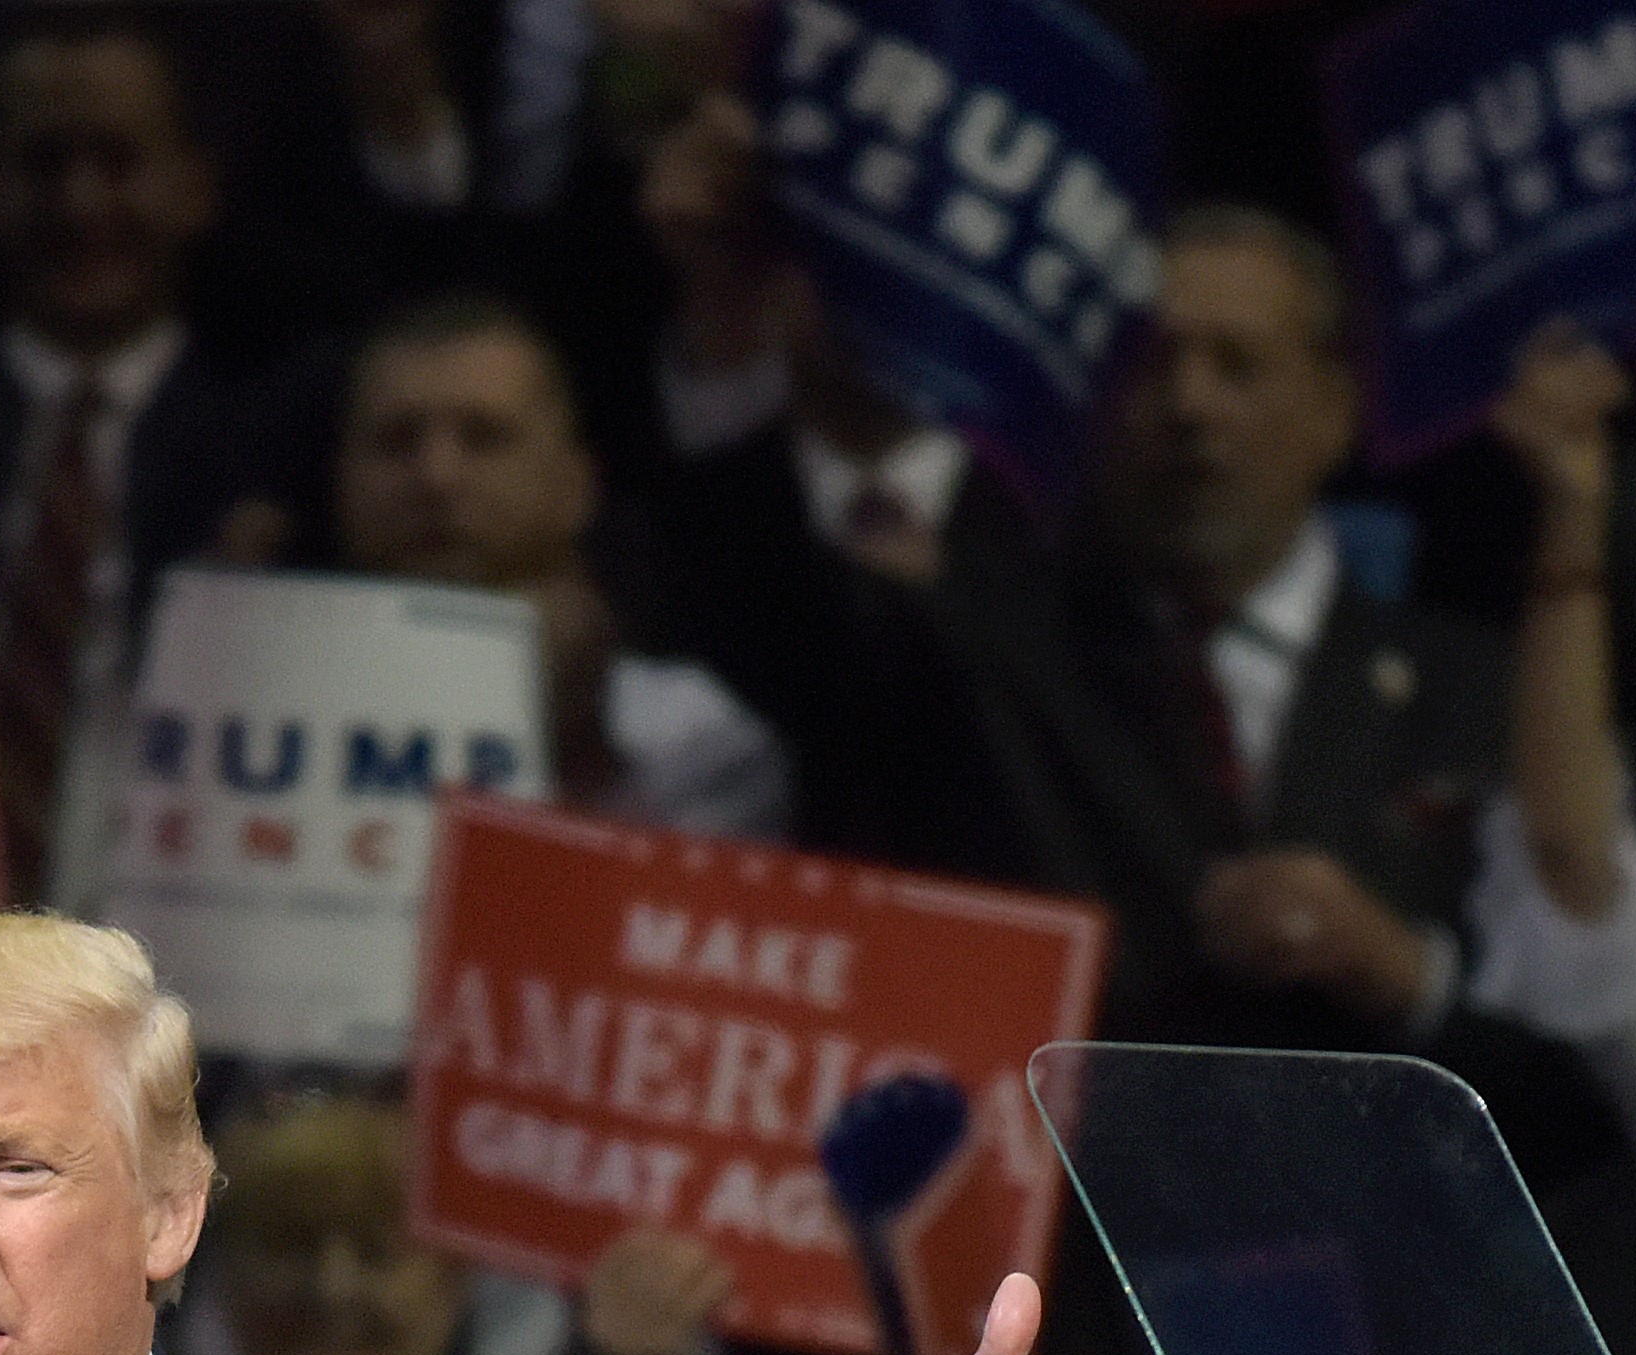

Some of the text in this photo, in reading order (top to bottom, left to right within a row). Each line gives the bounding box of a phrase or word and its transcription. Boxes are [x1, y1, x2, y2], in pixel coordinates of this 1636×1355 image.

[142, 710, 518, 792] RUMP
[619, 901, 858, 1010] MAKE
[451, 1098, 691, 1217] GREAT
